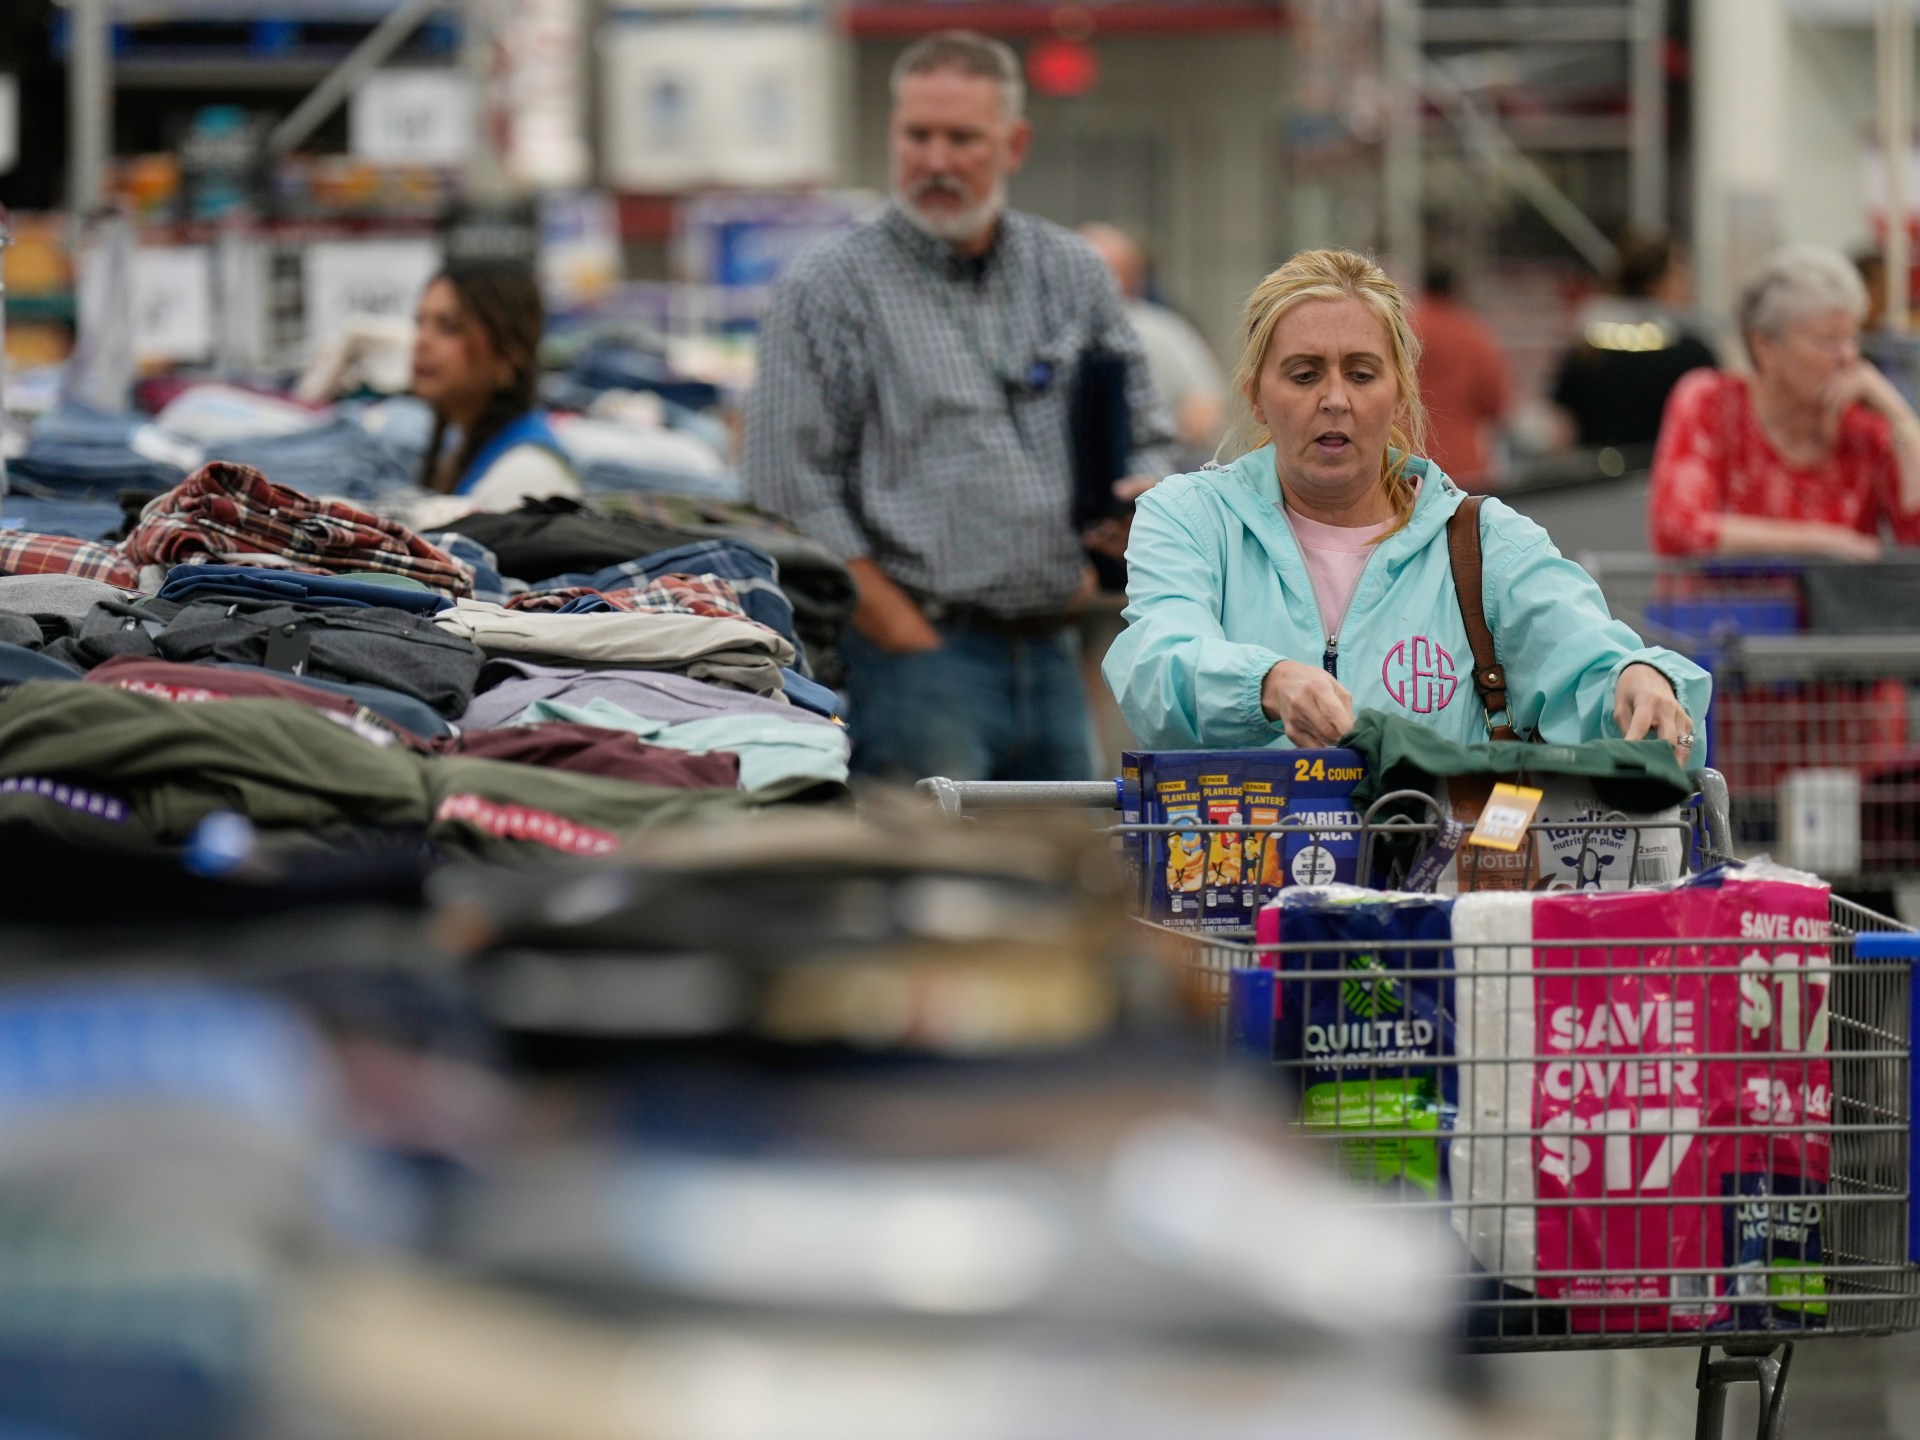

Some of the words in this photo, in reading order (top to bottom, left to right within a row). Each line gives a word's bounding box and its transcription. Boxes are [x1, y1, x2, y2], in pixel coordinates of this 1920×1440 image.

[1294, 758, 1326, 782] 24
[1327, 767, 1364, 781] COUNT
[1161, 793, 1201, 805] PLANTERS
[1203, 786, 1243, 798] PLANTERS
[1244, 795, 1286, 807] PLANTERS
[1209, 806, 1238, 814] PEANUTS
[1600, 838, 1622, 849] plan
[1740, 911, 1790, 939] SAVE
[1793, 917, 1829, 942] OVE
[1740, 948, 1831, 1053] $17
[1304, 1019, 1433, 1053] QUILTED
[1549, 1001, 1694, 1050] SAVE
[1544, 1057, 1699, 1101] OVER
[1539, 1107, 1699, 1190] $17
[1743, 1221, 1809, 1244] NOHER
